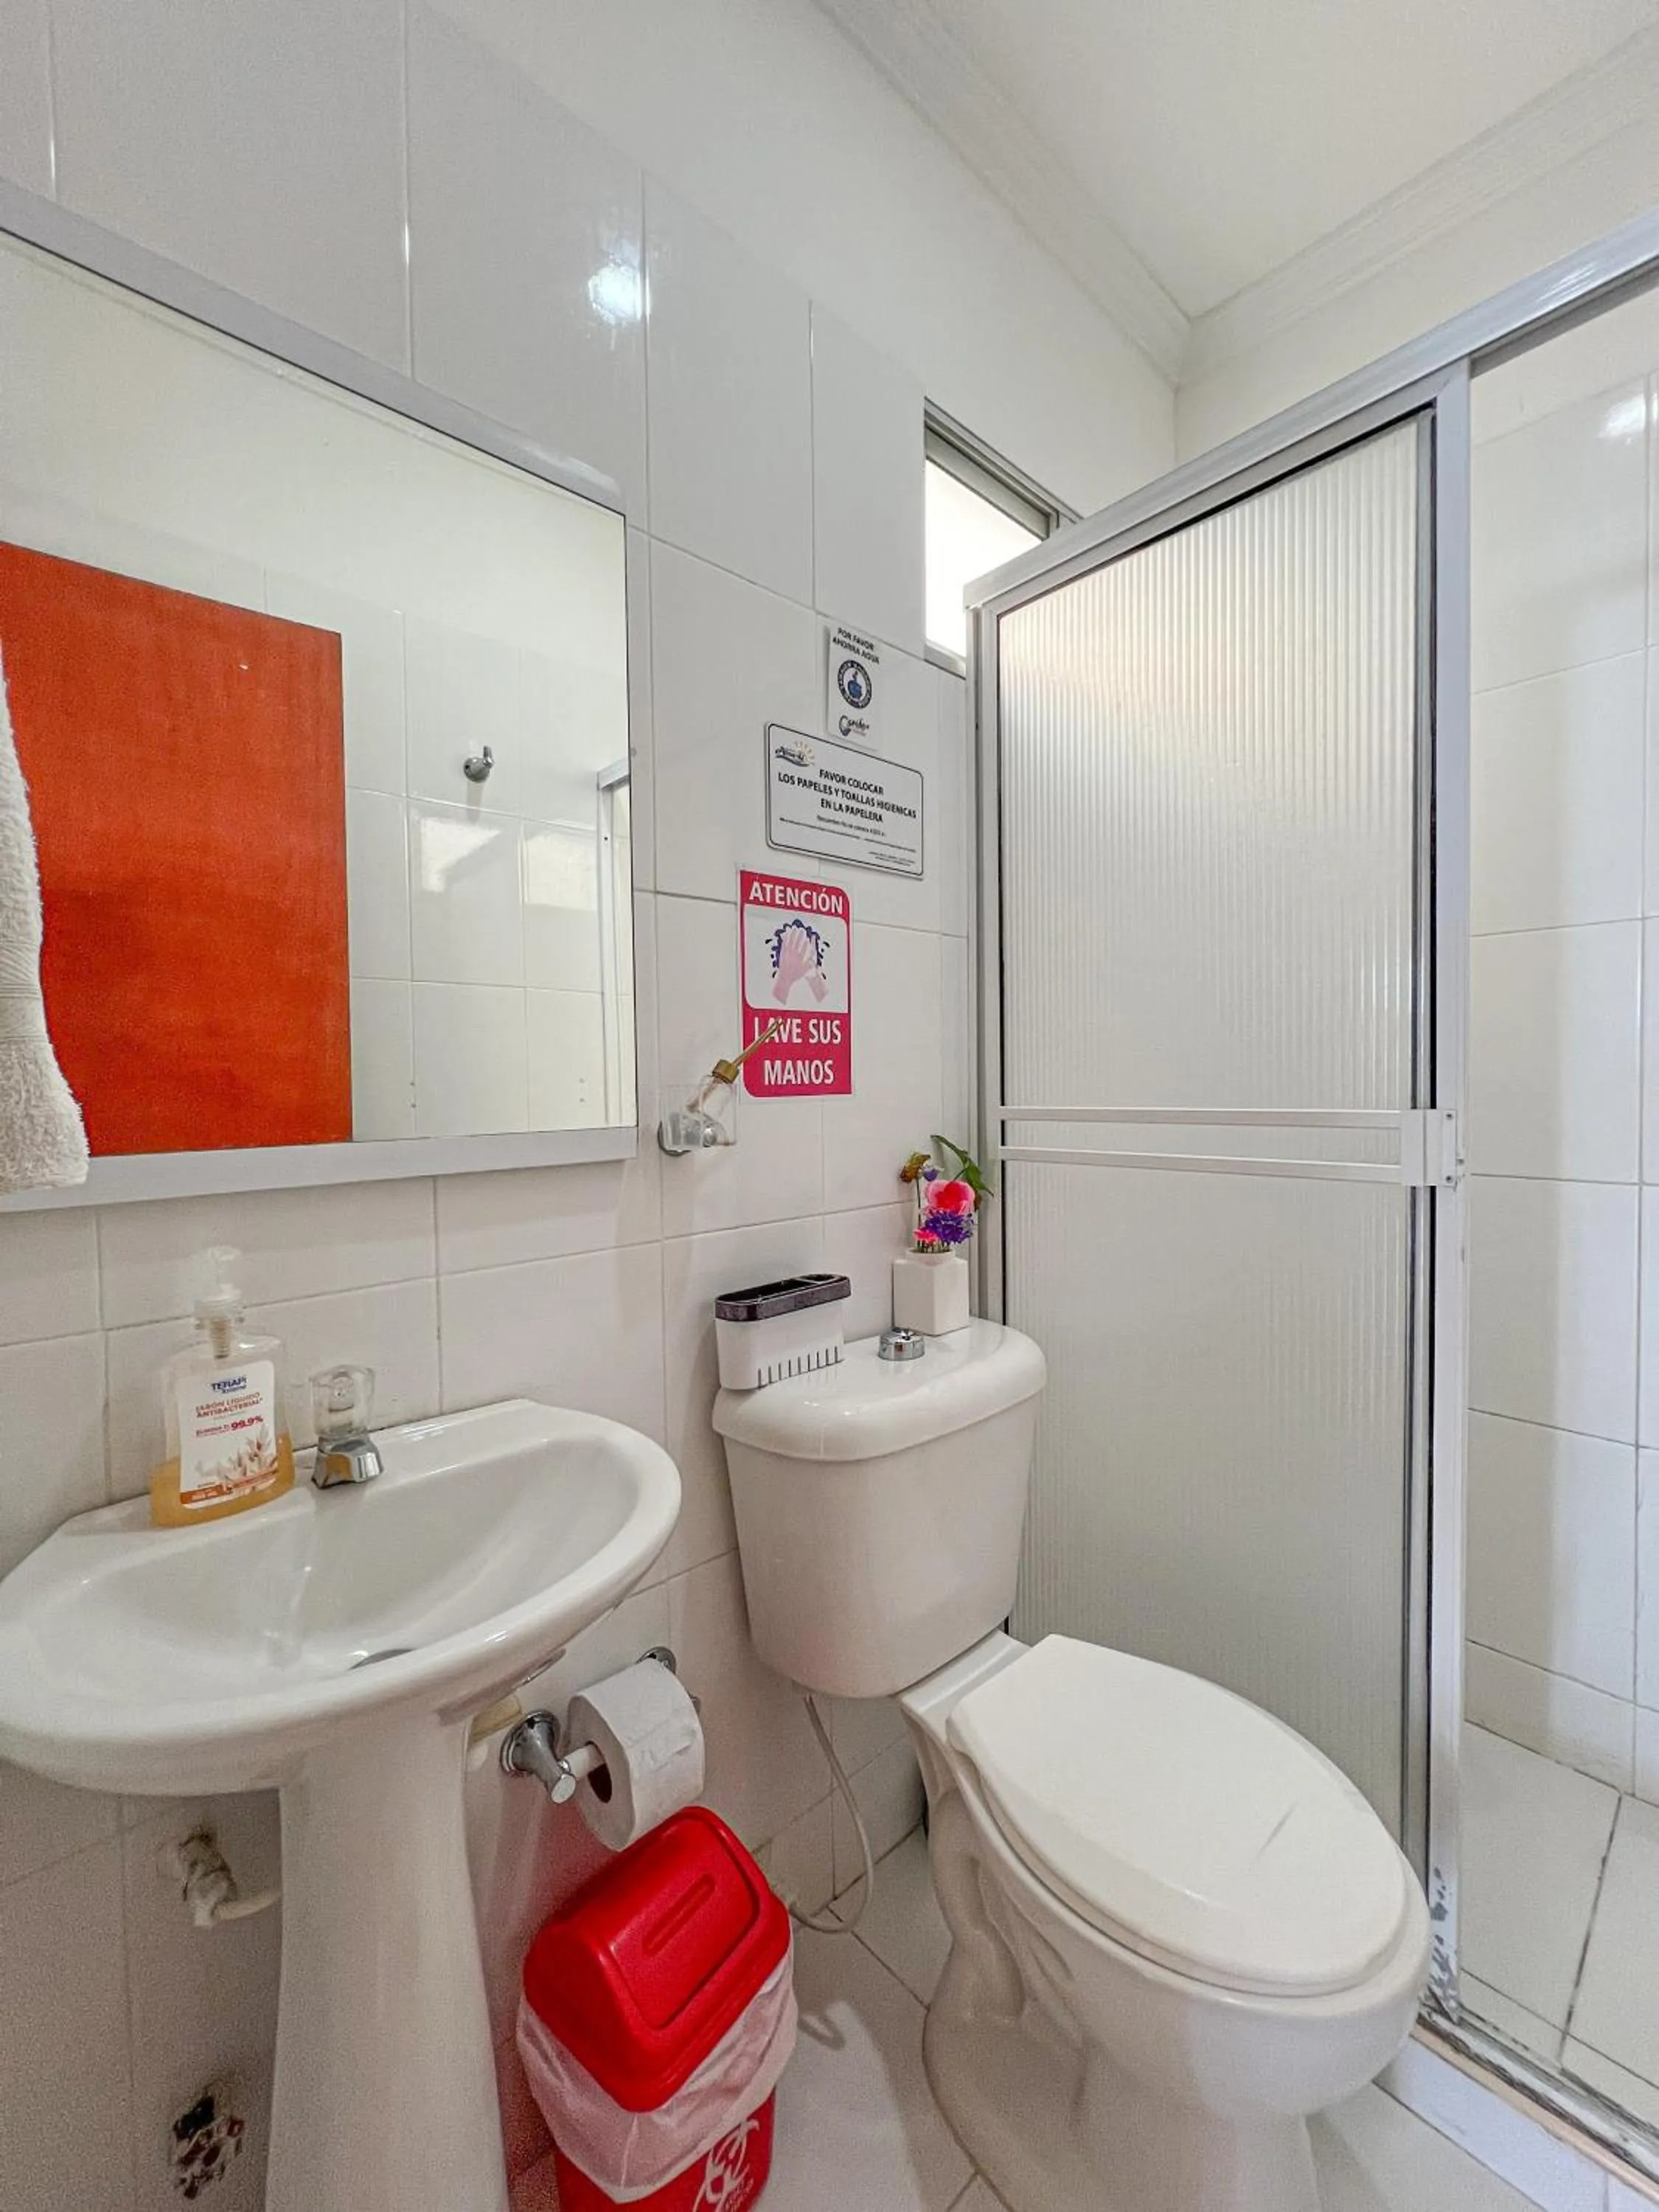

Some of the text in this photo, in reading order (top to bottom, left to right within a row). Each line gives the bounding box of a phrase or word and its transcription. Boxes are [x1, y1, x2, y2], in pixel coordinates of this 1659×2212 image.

[833, 636, 880, 664] AHORRA AGUA
[838, 627, 874, 650] POR FAVOR
[778, 772, 917, 818] LOS PAPELES Y TOALLAS HIGIENICAS
[819, 768, 884, 796] FAVOR COLOCAR
[821, 798, 883, 823] EN LA PAPELERA
[749, 881, 844, 914] ATENCIÓN
[754, 1017, 842, 1045] LAVE SUS
[764, 1059, 834, 1086] MANOS
